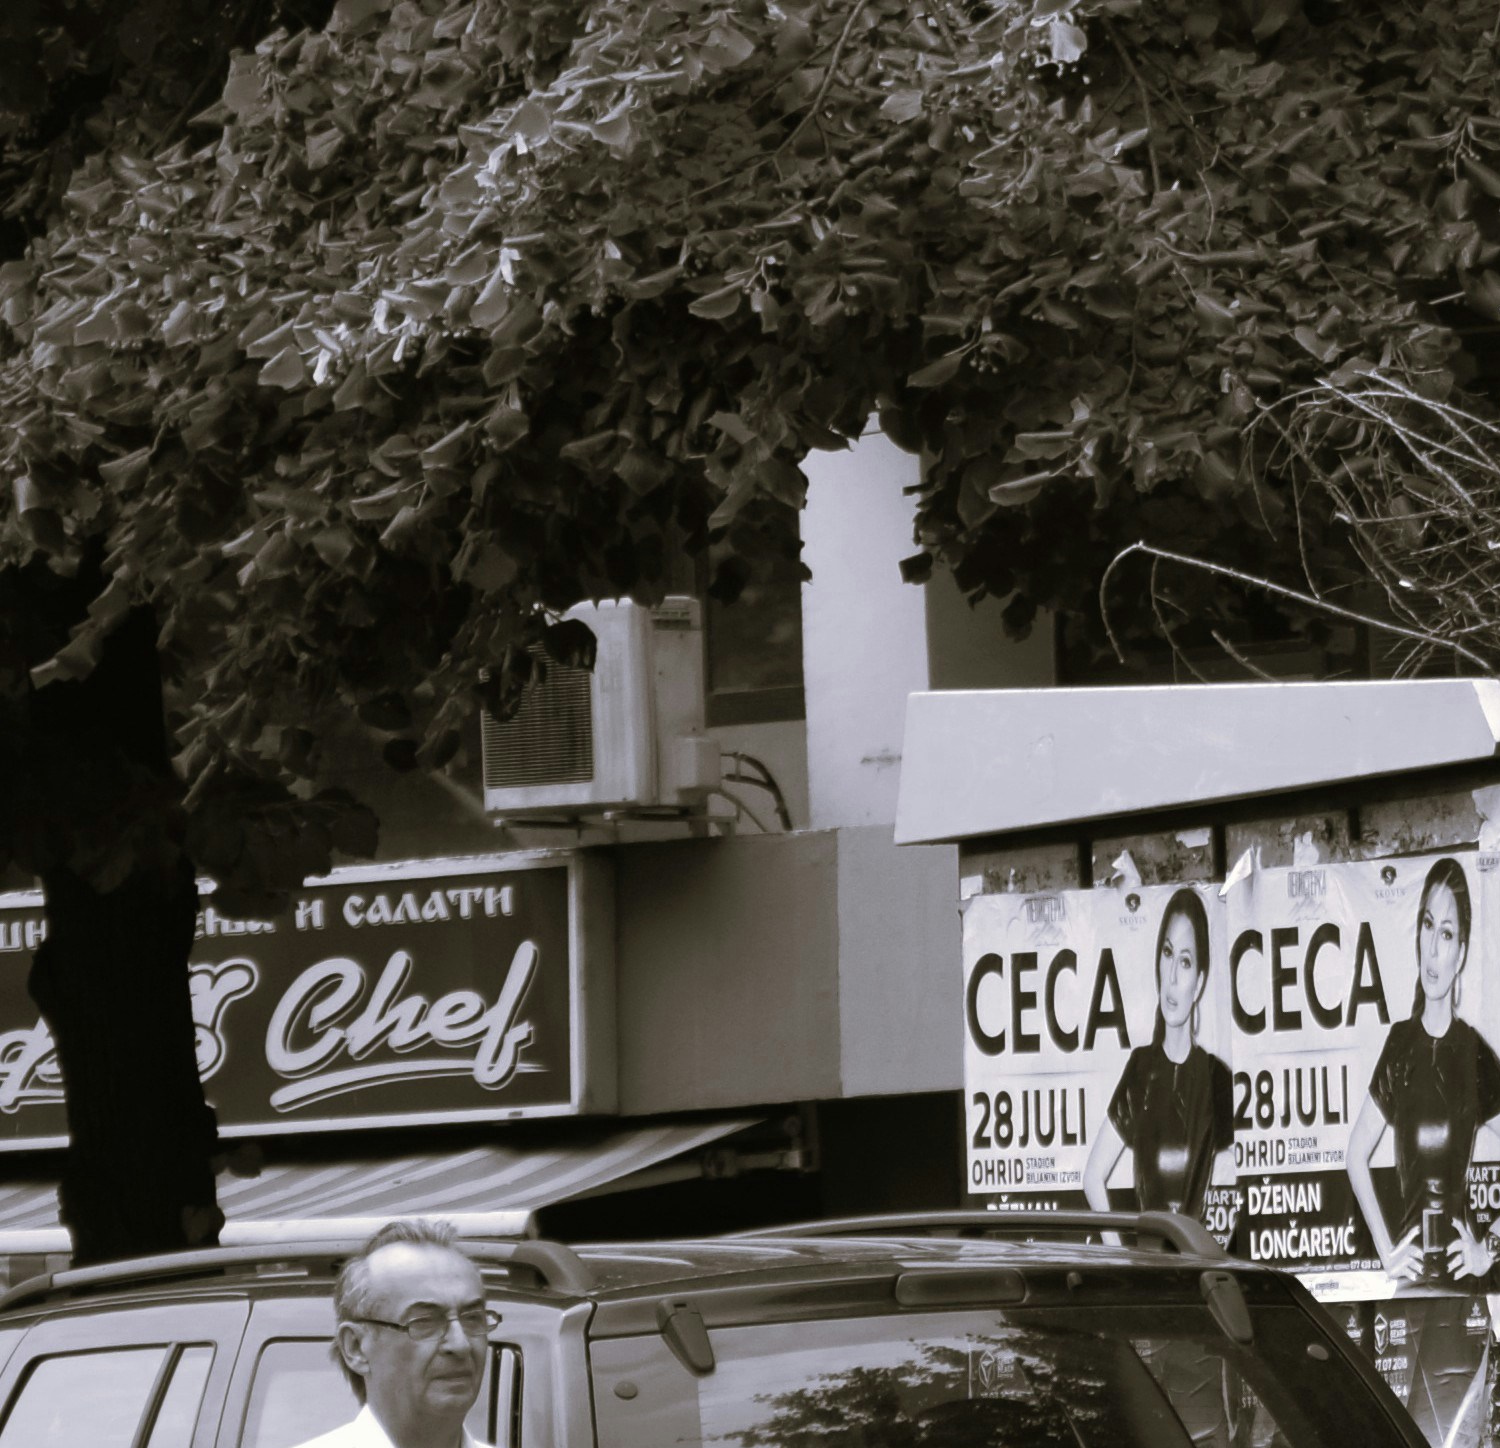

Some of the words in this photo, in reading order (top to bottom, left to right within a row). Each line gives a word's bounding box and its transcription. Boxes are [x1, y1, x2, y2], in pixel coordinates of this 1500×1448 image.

[966, 948, 1132, 1057] CECA
[1229, 922, 1390, 1036] CECA
[265, 939, 538, 1090] Chef
[973, 1090, 1014, 1150] 28
[1018, 1087, 1087, 1149] JULI
[1234, 1069, 1275, 1130] 28
[1280, 1065, 1349, 1128] JULI
[972, 1157, 1025, 1186] OHRID
[1234, 1138, 1286, 1168] OHRID
[1248, 1178, 1321, 1215] DŽENAN
[1250, 1217, 1356, 1261] LONČAREVIĆ
